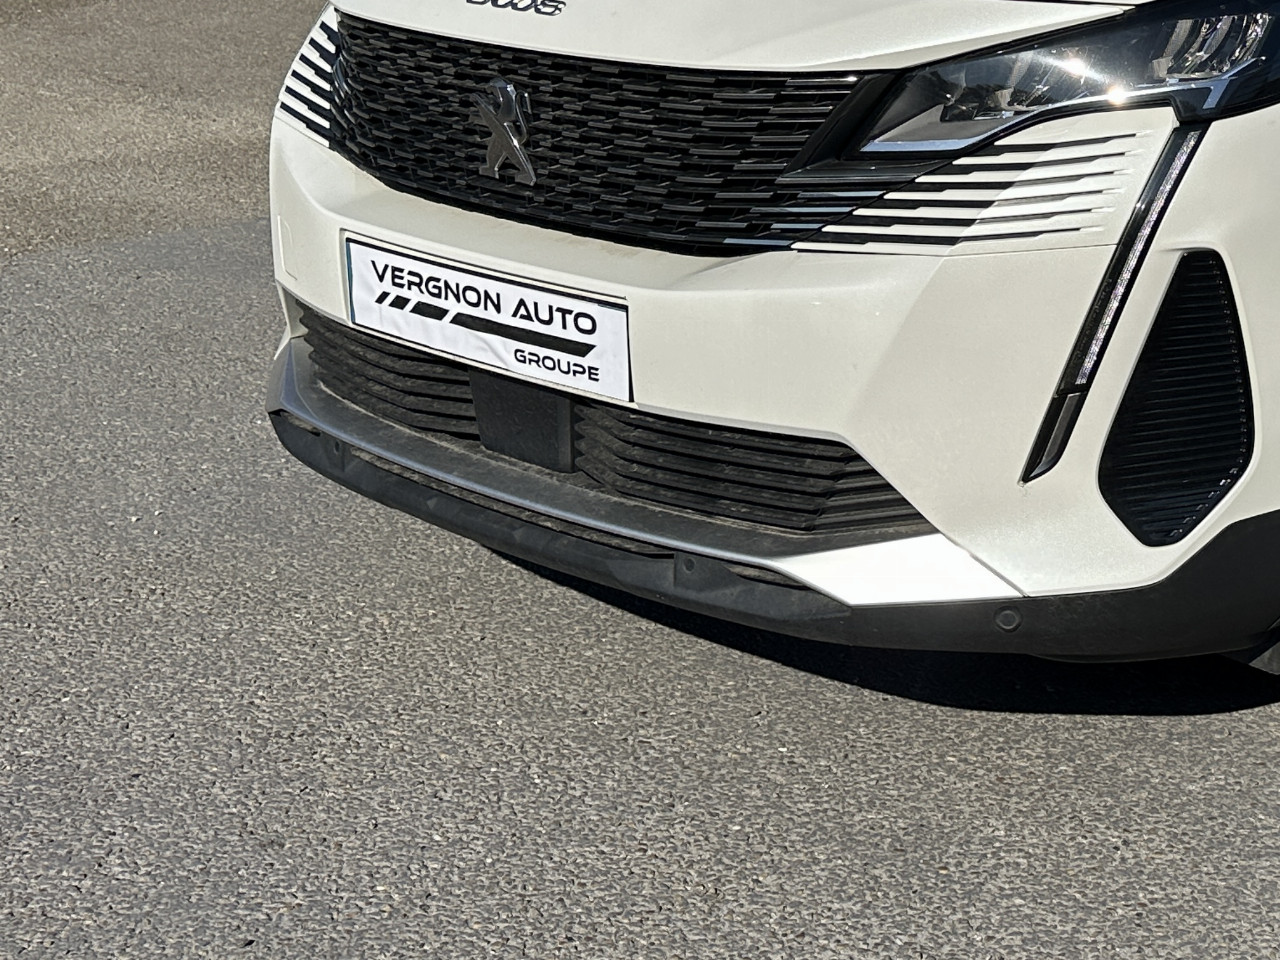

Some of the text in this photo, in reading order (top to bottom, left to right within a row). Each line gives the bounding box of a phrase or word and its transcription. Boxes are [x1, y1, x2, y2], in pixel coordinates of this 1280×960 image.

[370, 259, 598, 336] VERGNON AUTO
[513, 348, 600, 382] GROUPE
